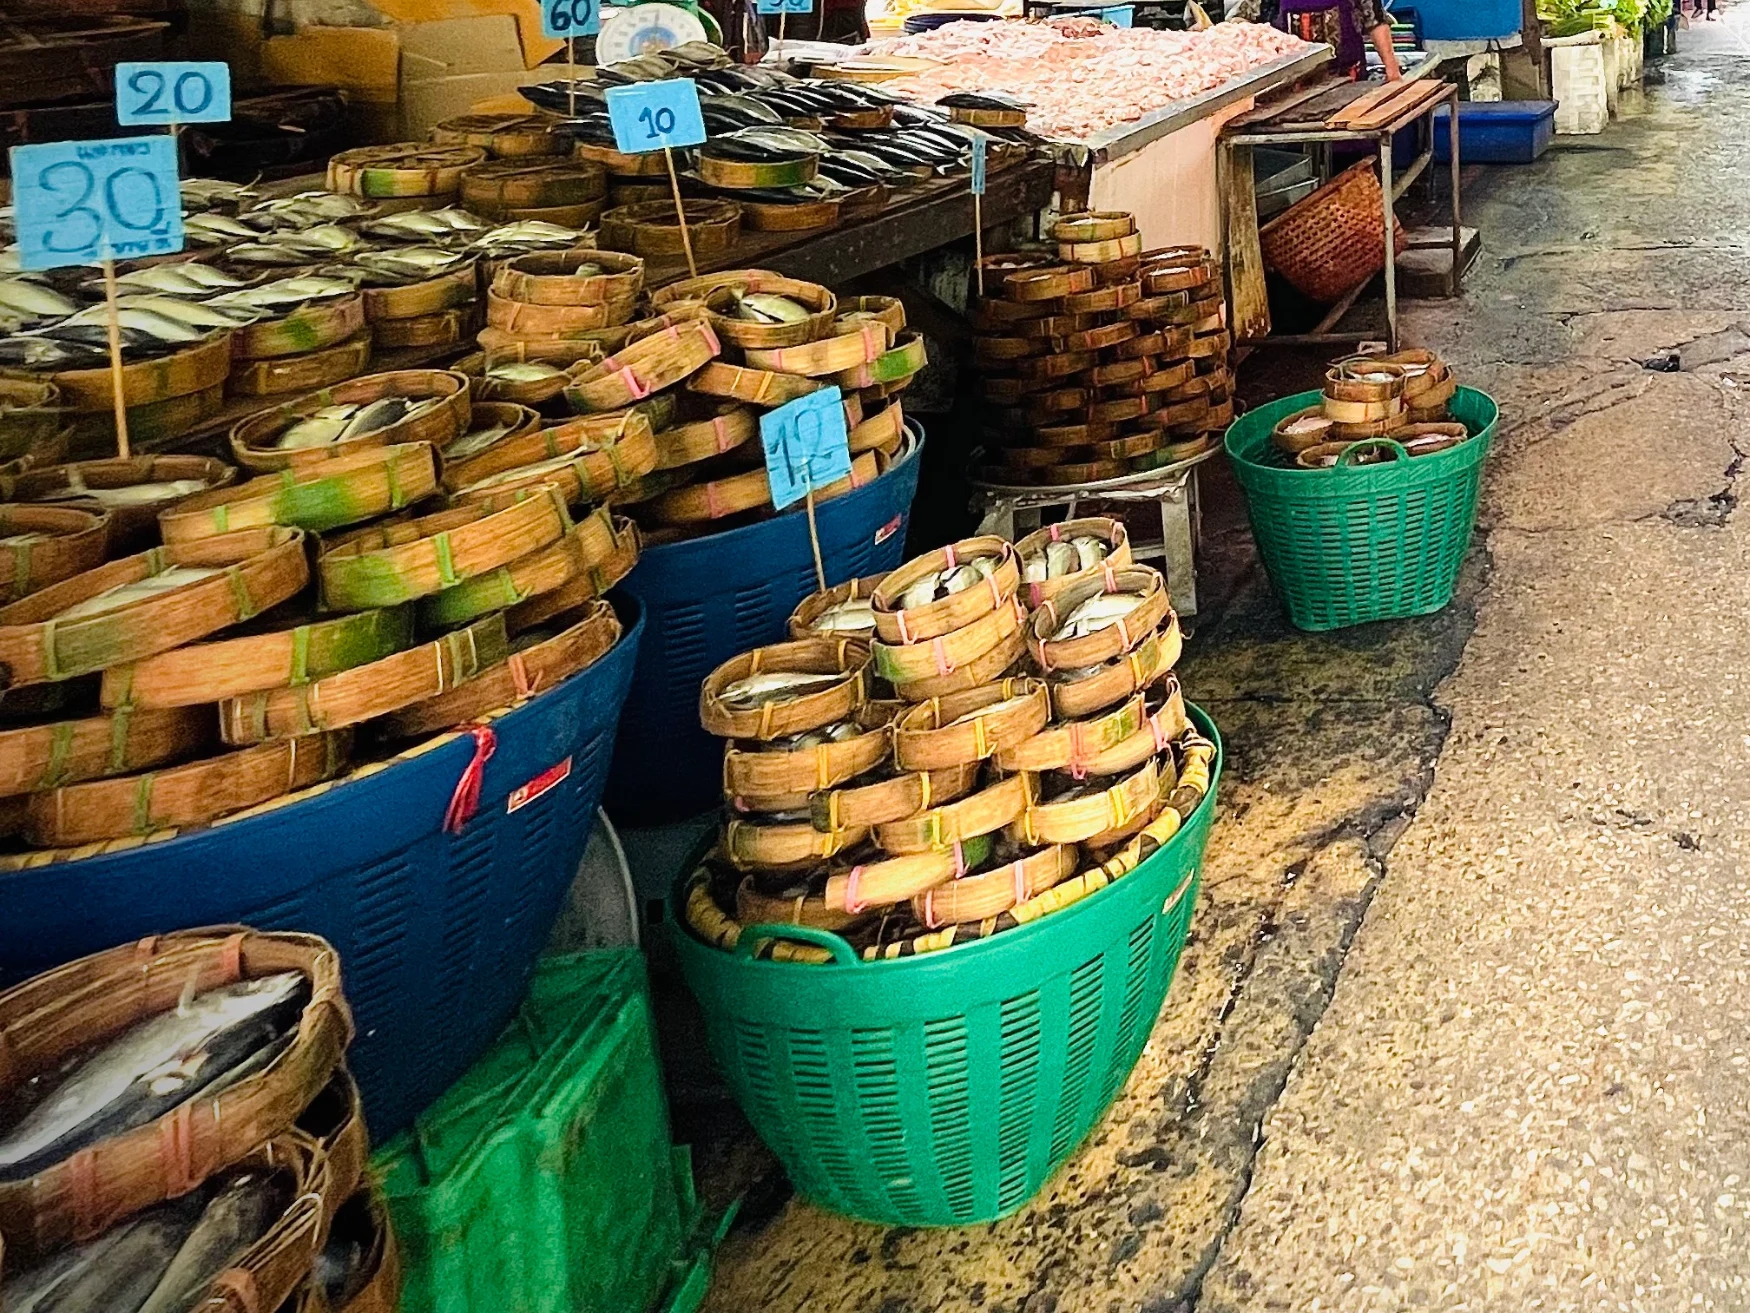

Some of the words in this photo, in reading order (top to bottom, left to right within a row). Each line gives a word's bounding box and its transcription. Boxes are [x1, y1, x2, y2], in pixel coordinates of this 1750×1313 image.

[127, 69, 213, 116] 20
[638, 106, 676, 139] 10
[38, 160, 166, 254] 30
